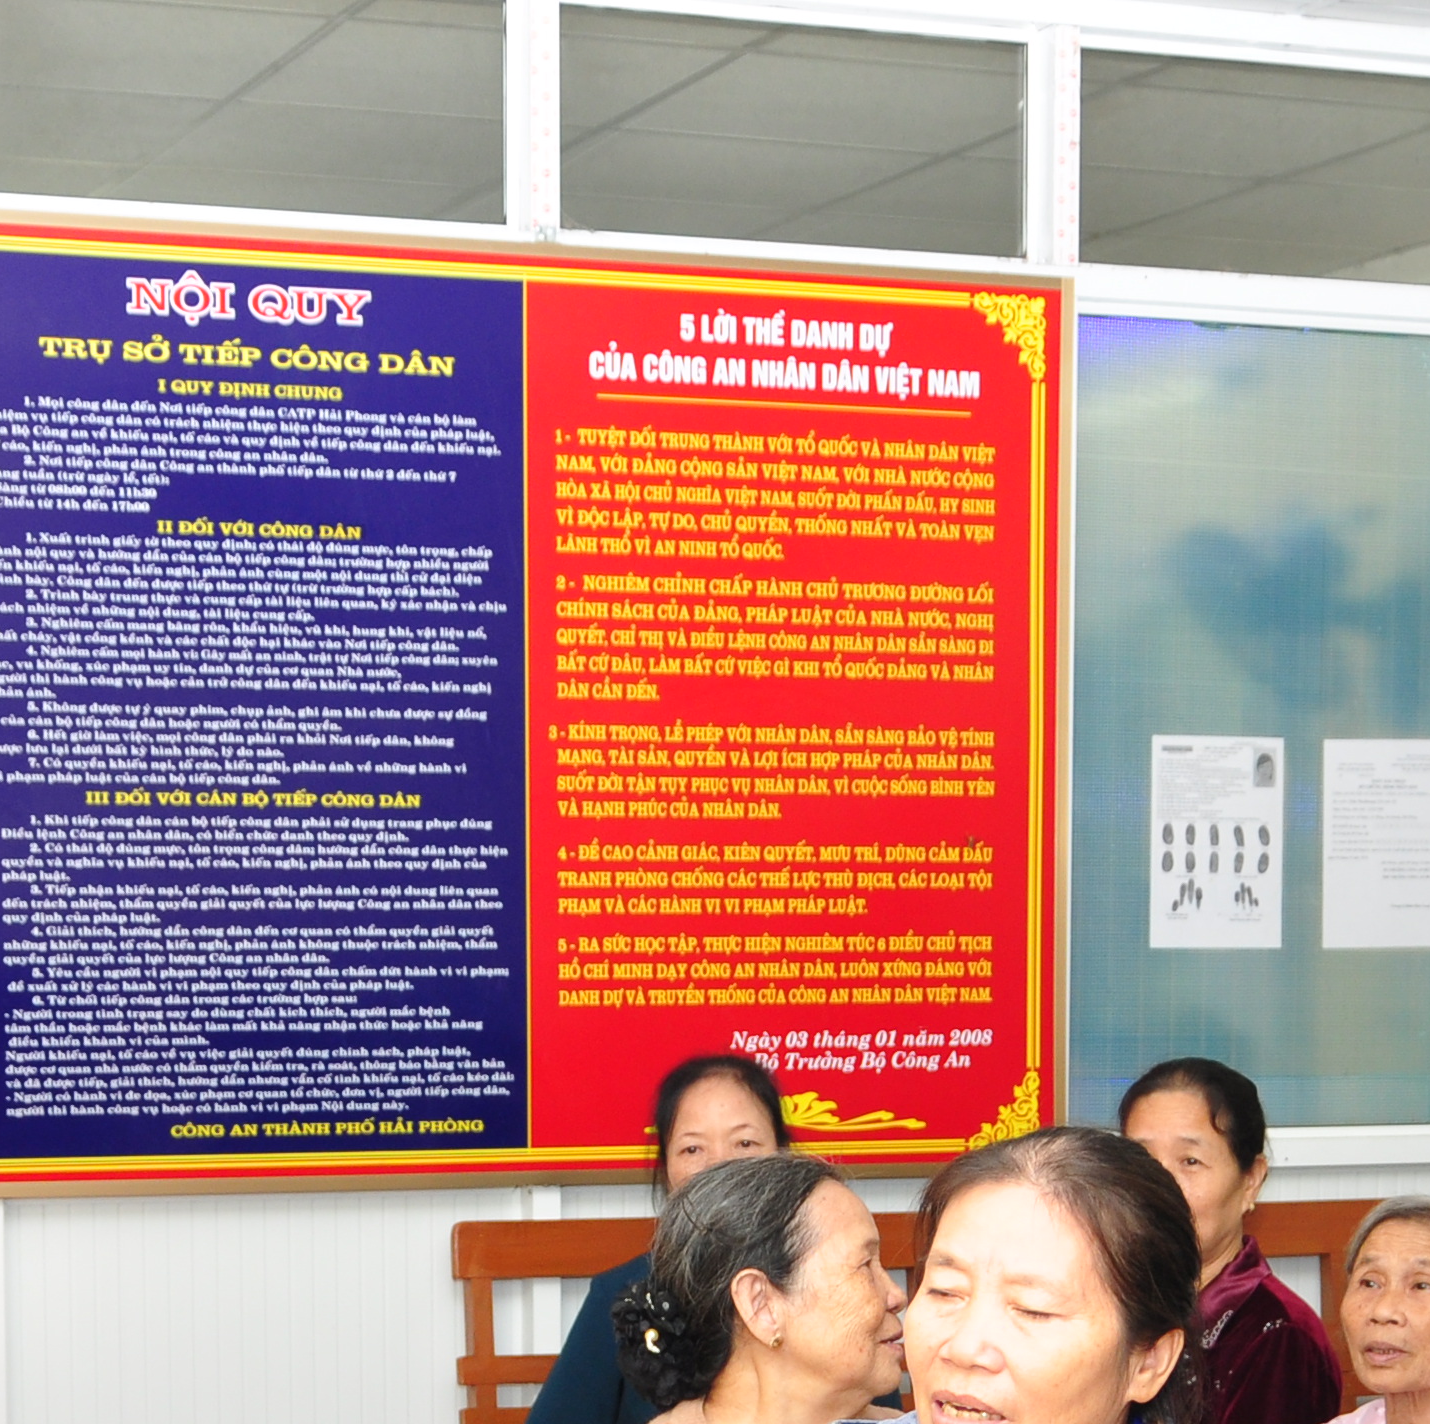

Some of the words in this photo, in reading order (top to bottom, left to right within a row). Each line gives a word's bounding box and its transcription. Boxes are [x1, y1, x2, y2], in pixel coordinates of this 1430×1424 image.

[125, 269, 236, 327] NỘI
[247, 283, 373, 327] QUY
[38, 336, 113, 365] TRỤ
[122, 334, 171, 364] SỞ
[178, 337, 262, 368] TIẾP
[269, 343, 370, 373] CÔNG
[679, 313, 696, 342] 5
[700, 310, 738, 345] LỜI
[742, 313, 785, 347] THỀ
[790, 319, 854, 351] DANH
[859, 321, 894, 357] DỰ
[588, 341, 638, 382] CỦA
[642, 350, 708, 385] CÔNG
[712, 357, 746, 387] AN
[751, 356, 817, 391] NHÂN
[821, 359, 870, 393] DÂN
[874, 362, 923, 399] VIỆT
[927, 368, 981, 399] NAM
